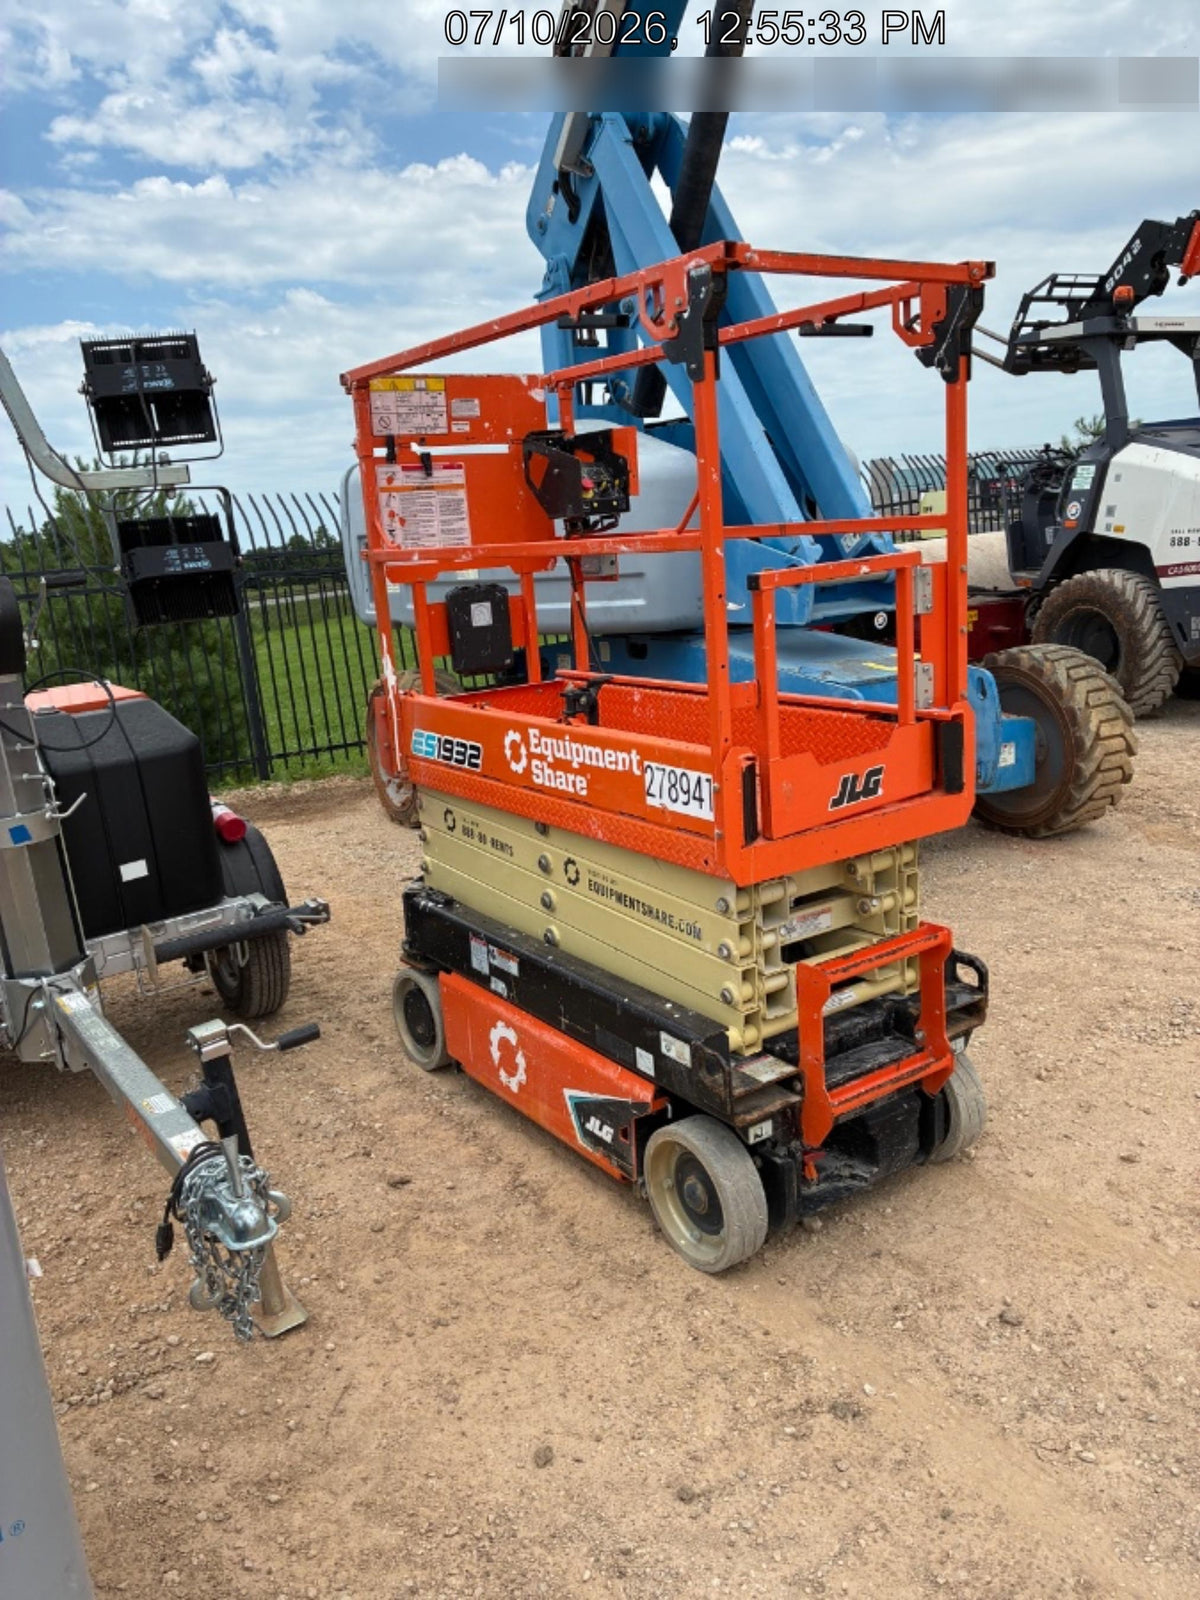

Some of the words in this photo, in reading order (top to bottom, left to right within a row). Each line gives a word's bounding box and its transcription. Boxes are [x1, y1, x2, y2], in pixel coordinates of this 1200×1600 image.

[412, 729, 482, 771] ES1932
[528, 728, 642, 776] Equipment
[531, 759, 588, 796] Share
[829, 764, 885, 811] JLG
[587, 878, 703, 941] EQUIPMENTSHARE.COM
[585, 1115, 614, 1143] JLG
